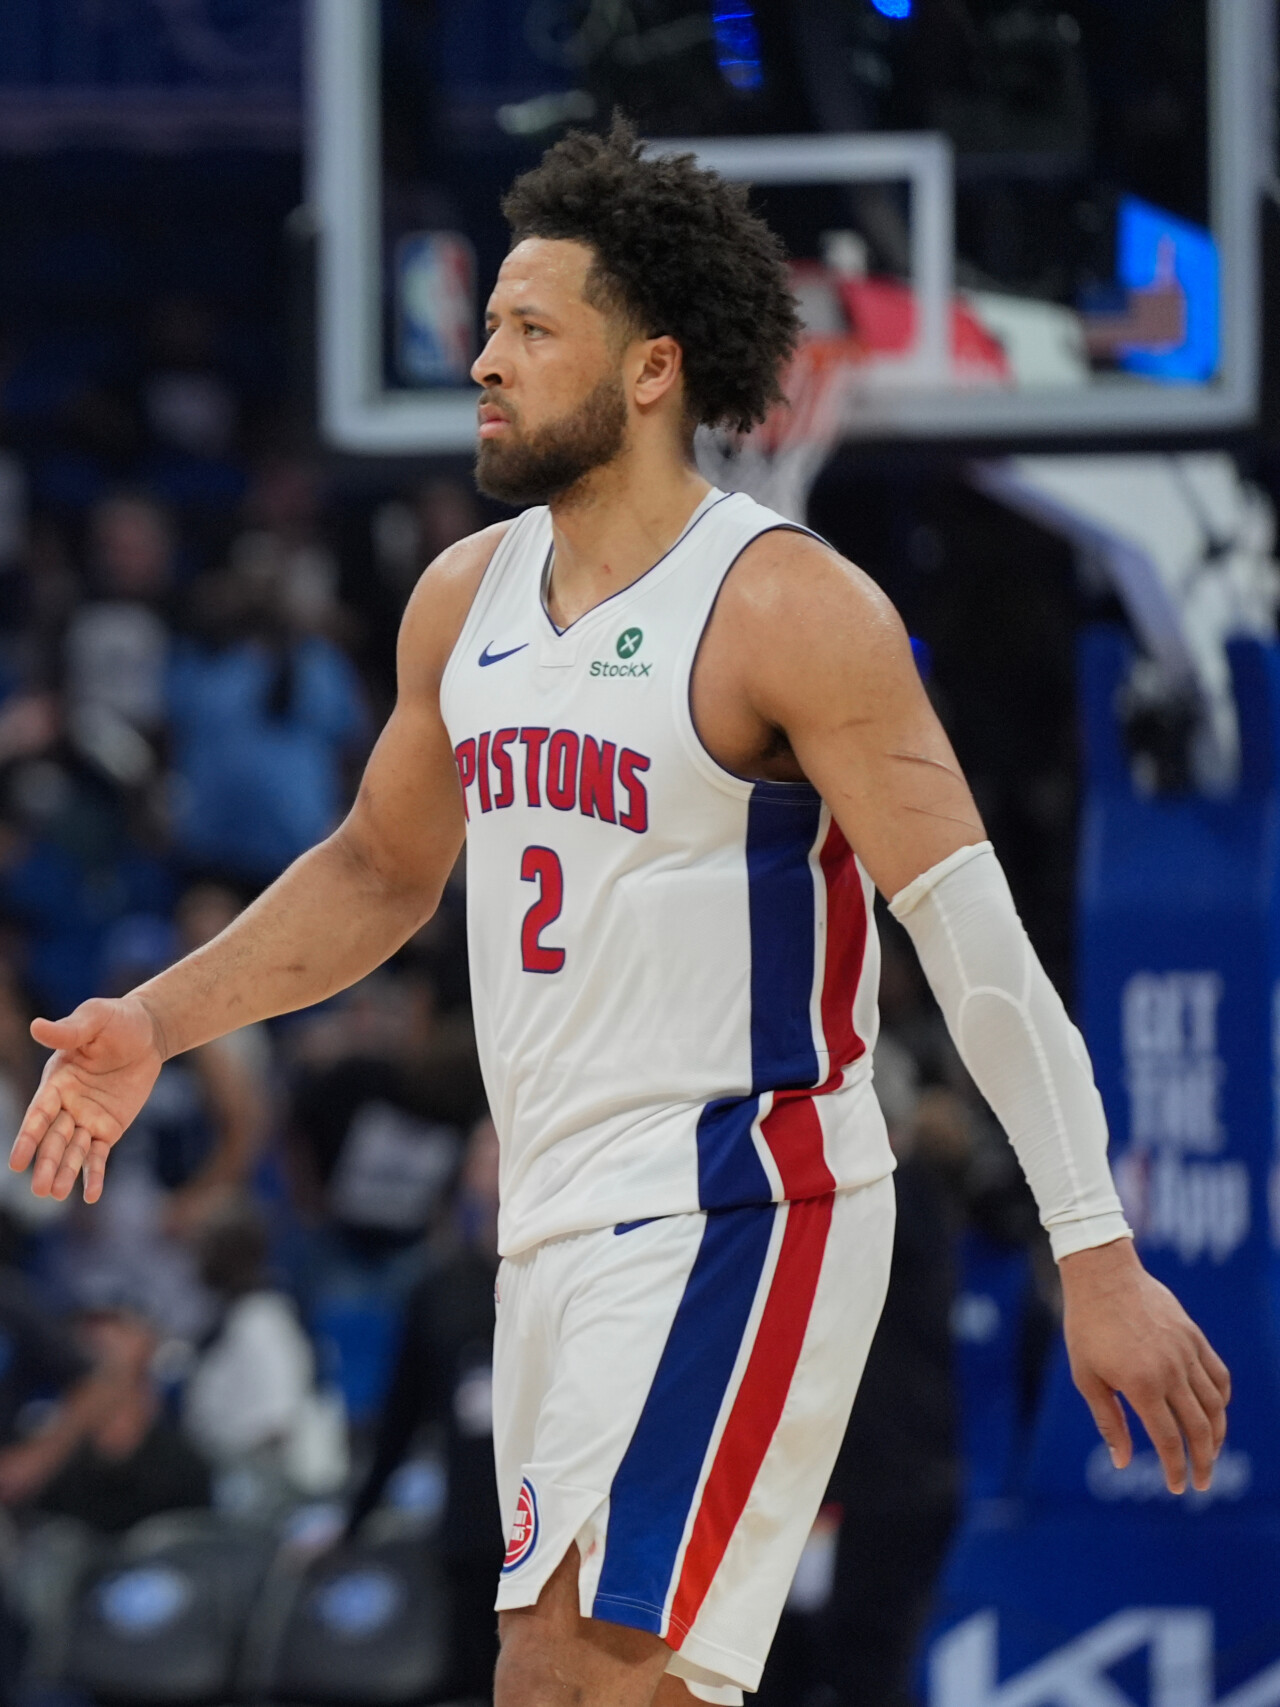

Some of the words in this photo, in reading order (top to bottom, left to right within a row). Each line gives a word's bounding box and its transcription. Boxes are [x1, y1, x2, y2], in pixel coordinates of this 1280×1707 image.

[589, 661, 652, 677] StockX
[455, 727, 651, 834] PISTONS
[520, 845, 566, 974] 2
